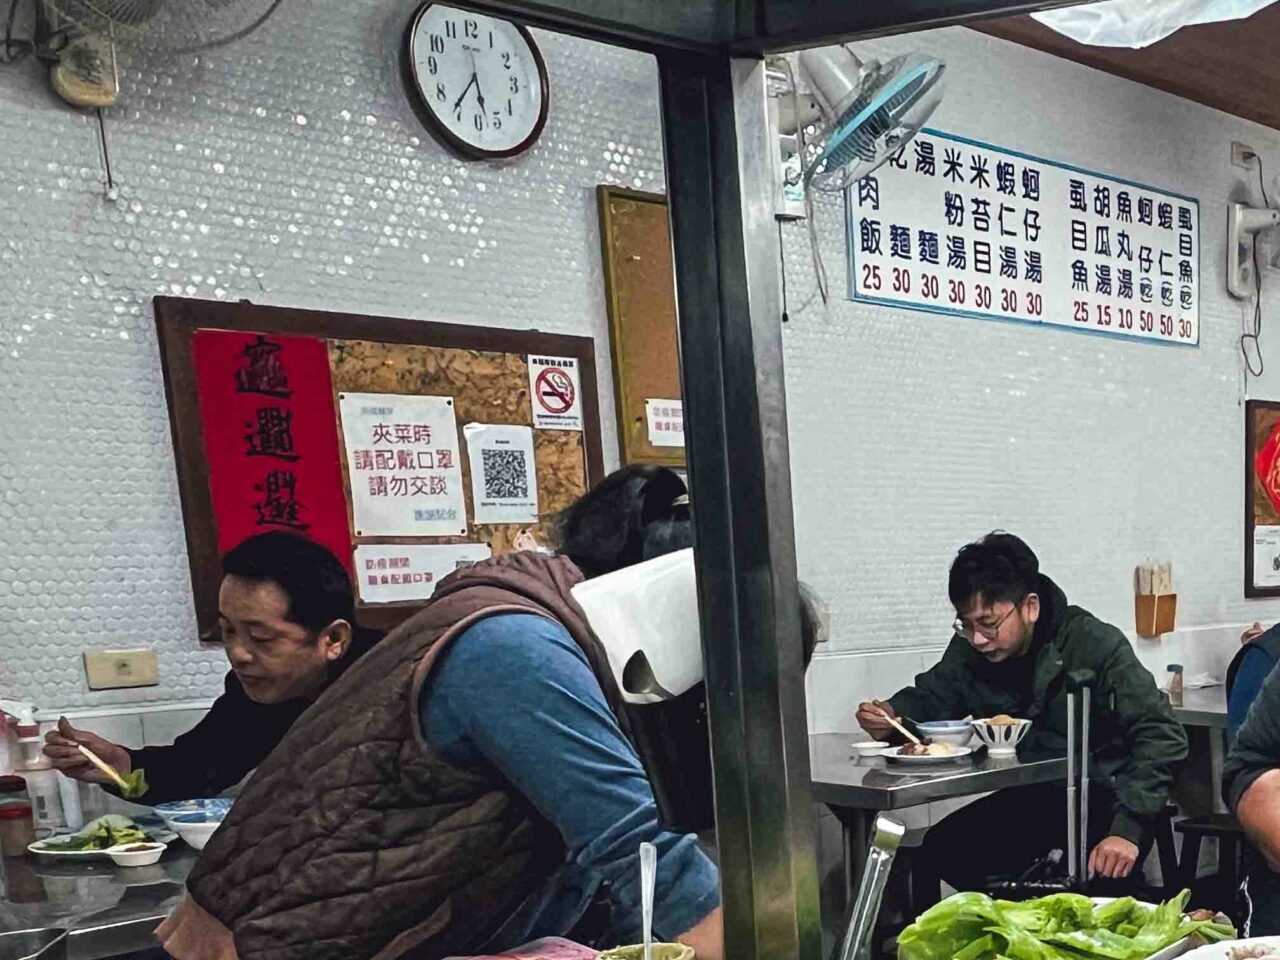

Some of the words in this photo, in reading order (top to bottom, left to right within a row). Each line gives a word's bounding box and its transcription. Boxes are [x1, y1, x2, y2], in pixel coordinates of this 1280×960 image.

[445, 20, 457, 39] 11
[465, 19, 478, 39] 12
[430, 34, 444, 54] 10
[428, 56, 438, 75] 9
[501, 52, 512, 70] 2
[436, 83, 446, 101] 8
[509, 76, 519, 94] 3
[858, 174, 883, 256] 肉飯
[943, 148, 967, 271] 米粉湯
[970, 154, 992, 274] 米苔目
[996, 160, 1018, 280] 蝦仁湯
[1022, 166, 1042, 284] 蚵仔湯
[1093, 184, 1112, 296] 胡瓜湯
[1116, 190, 1133, 299] 魚丸湯
[862, 264, 882, 291] 25
[892, 267, 911, 293] 30
[921, 273, 939, 299] 30
[948, 279, 965, 304] 30
[975, 284, 992, 309] 30
[1001, 288, 1017, 313] 30
[1026, 291, 1042, 316] 30
[1074, 301, 1089, 322] 25
[1096, 304, 1112, 326] 15
[1118, 308, 1133, 329] 10
[1140, 311, 1153, 332] 50
[1160, 314, 1173, 336] 50
[1179, 318, 1192, 339] 30
[373, 423, 432, 445] 夾菜時
[354, 449, 454, 470] 請配戴口罩
[368, 475, 448, 496] 請勿交談
